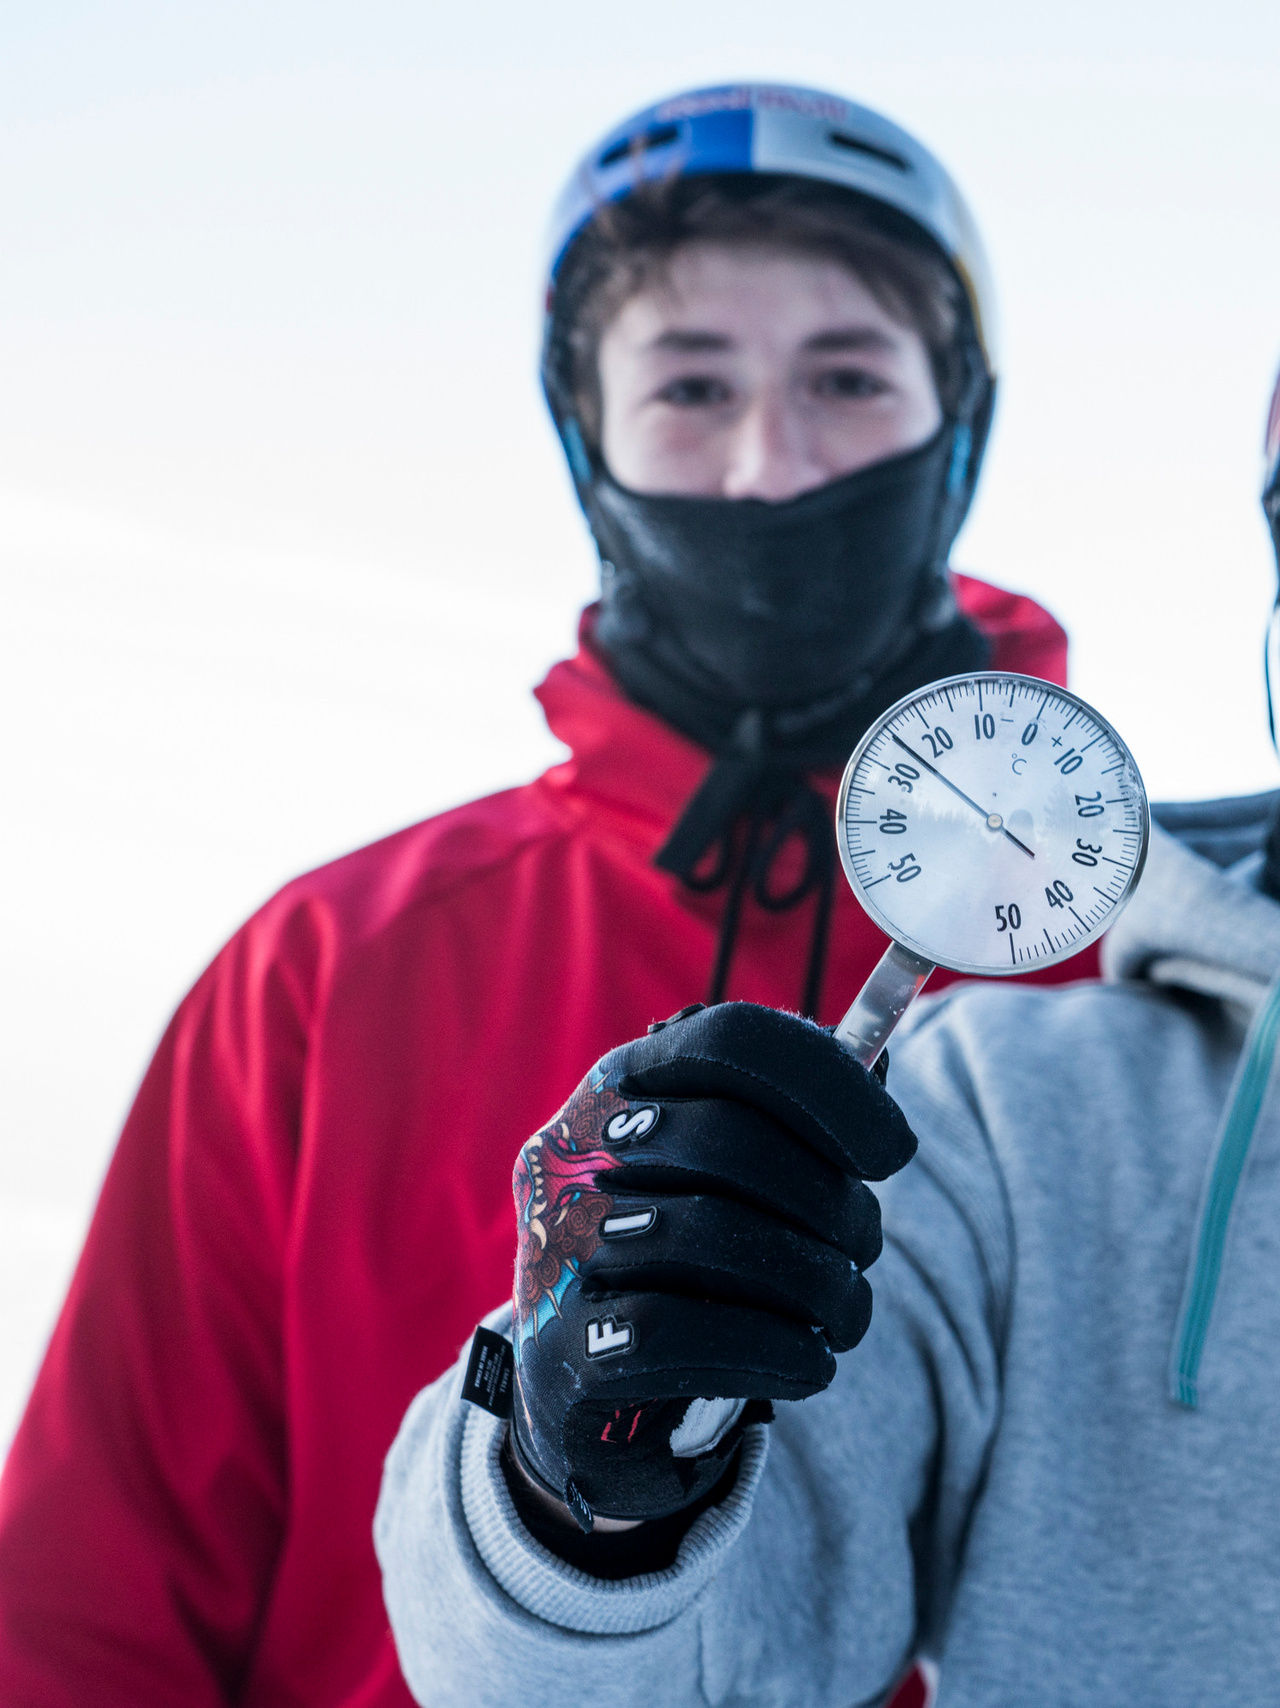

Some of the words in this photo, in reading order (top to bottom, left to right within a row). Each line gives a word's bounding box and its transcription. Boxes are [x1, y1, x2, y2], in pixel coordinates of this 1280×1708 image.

[974, 713, 996, 740] 10
[1021, 723, 1039, 746] 0
[921, 726, 954, 758] 20
[1054, 748, 1084, 775] 10
[887, 763, 920, 794] 30
[1074, 791, 1105, 818] 20
[879, 808, 907, 835] 40
[1071, 838, 1103, 867] 30
[887, 853, 922, 883] 50
[1044, 879, 1075, 910] 40
[995, 903, 1022, 932] 50
